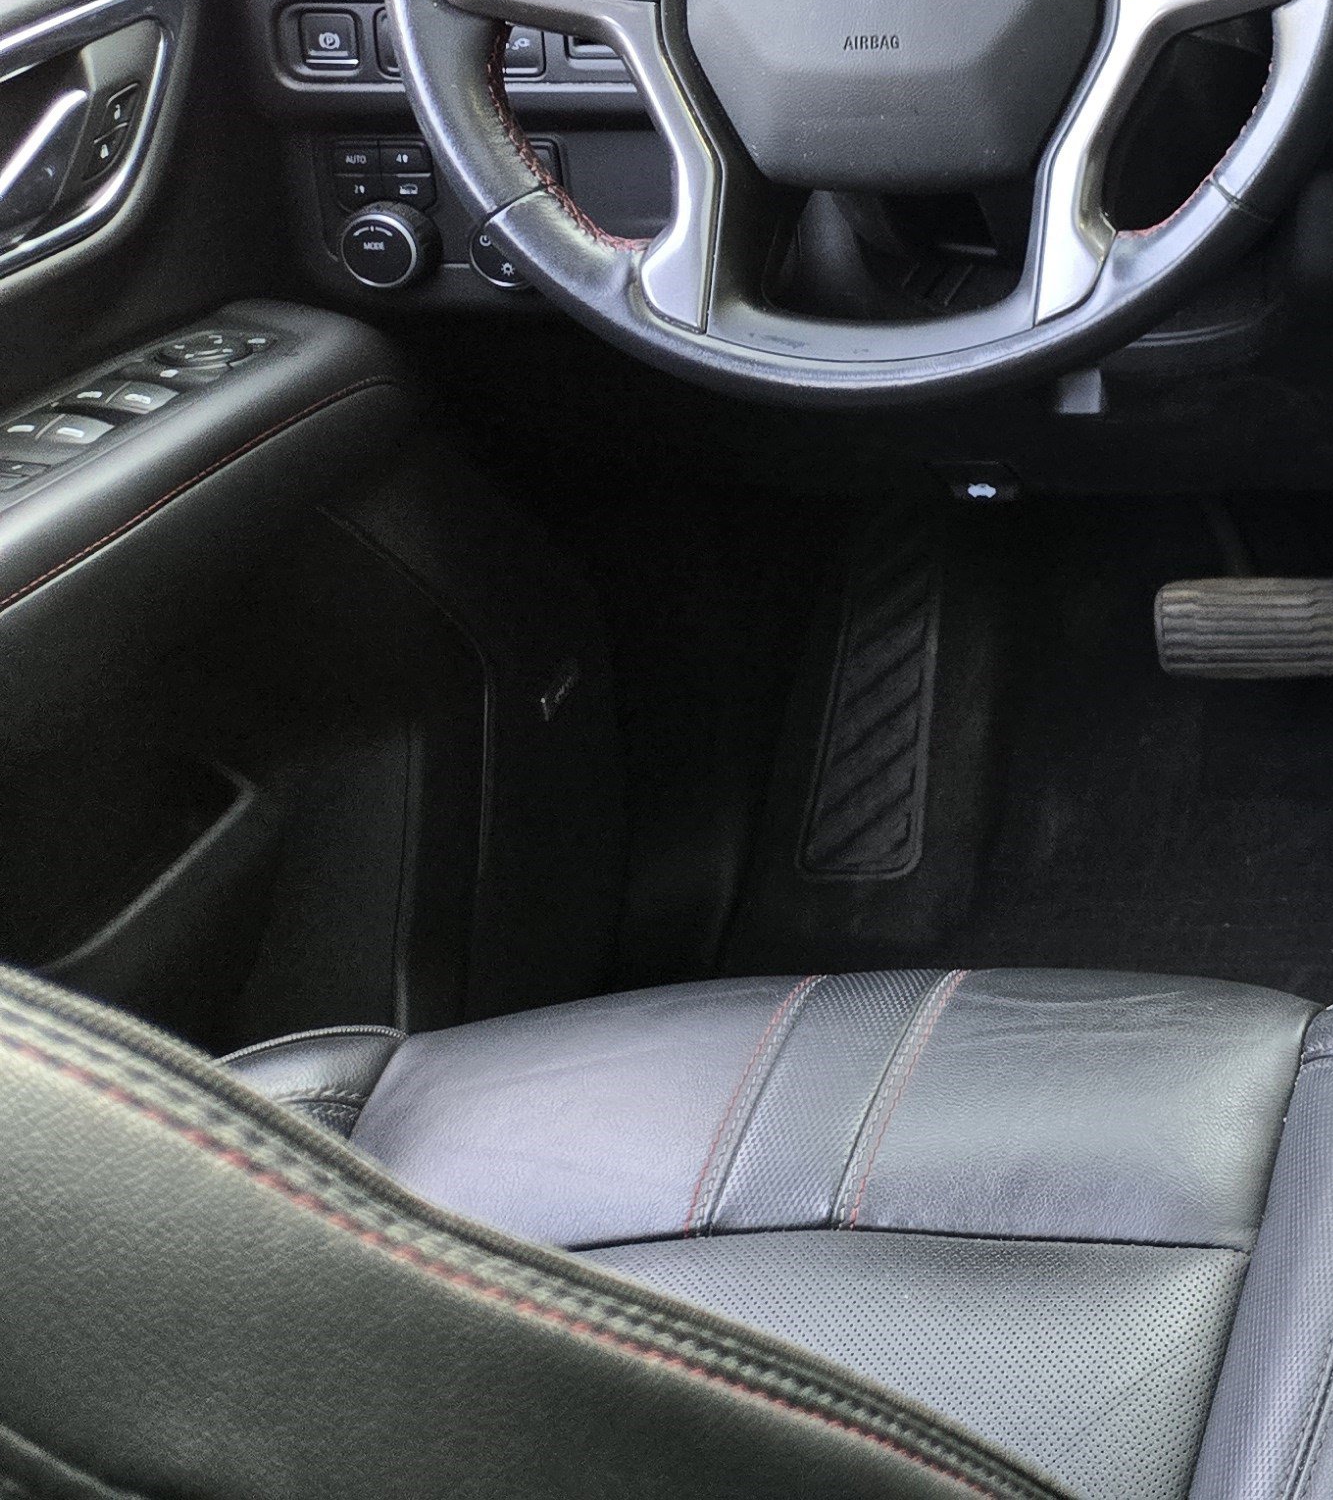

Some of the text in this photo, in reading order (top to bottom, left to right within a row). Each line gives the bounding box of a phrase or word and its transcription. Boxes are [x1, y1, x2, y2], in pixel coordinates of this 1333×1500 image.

[843, 34, 900, 51] AIRBAG
[346, 154, 367, 164] AUTO
[363, 242, 386, 250] MODE
